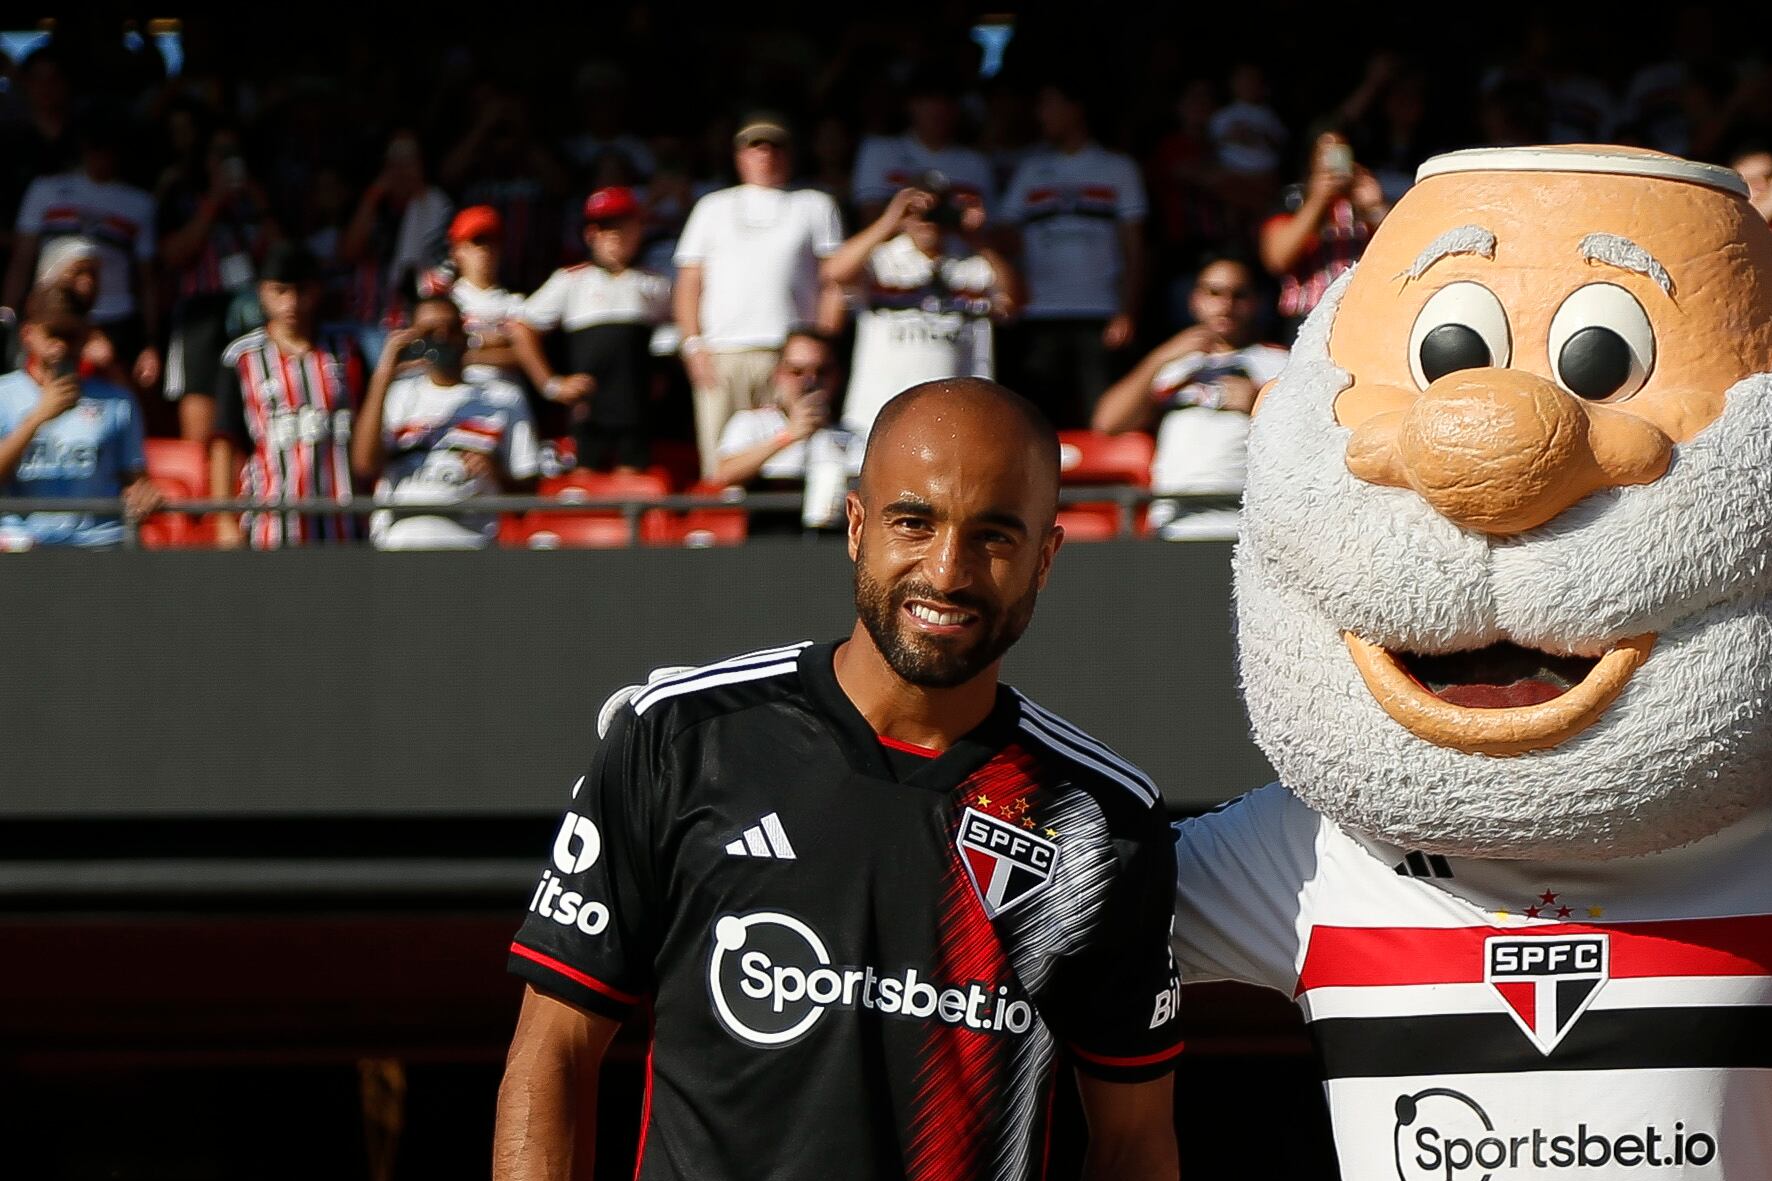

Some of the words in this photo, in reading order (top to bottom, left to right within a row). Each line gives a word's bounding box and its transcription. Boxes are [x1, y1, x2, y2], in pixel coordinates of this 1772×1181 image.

[968, 821, 1050, 868] SPFC
[529, 870, 610, 935] itso
[1495, 944, 1598, 972] SPFC
[740, 951, 1032, 1034] Sportsbet.io
[1415, 1121, 1716, 1181] Sportsbet.io
